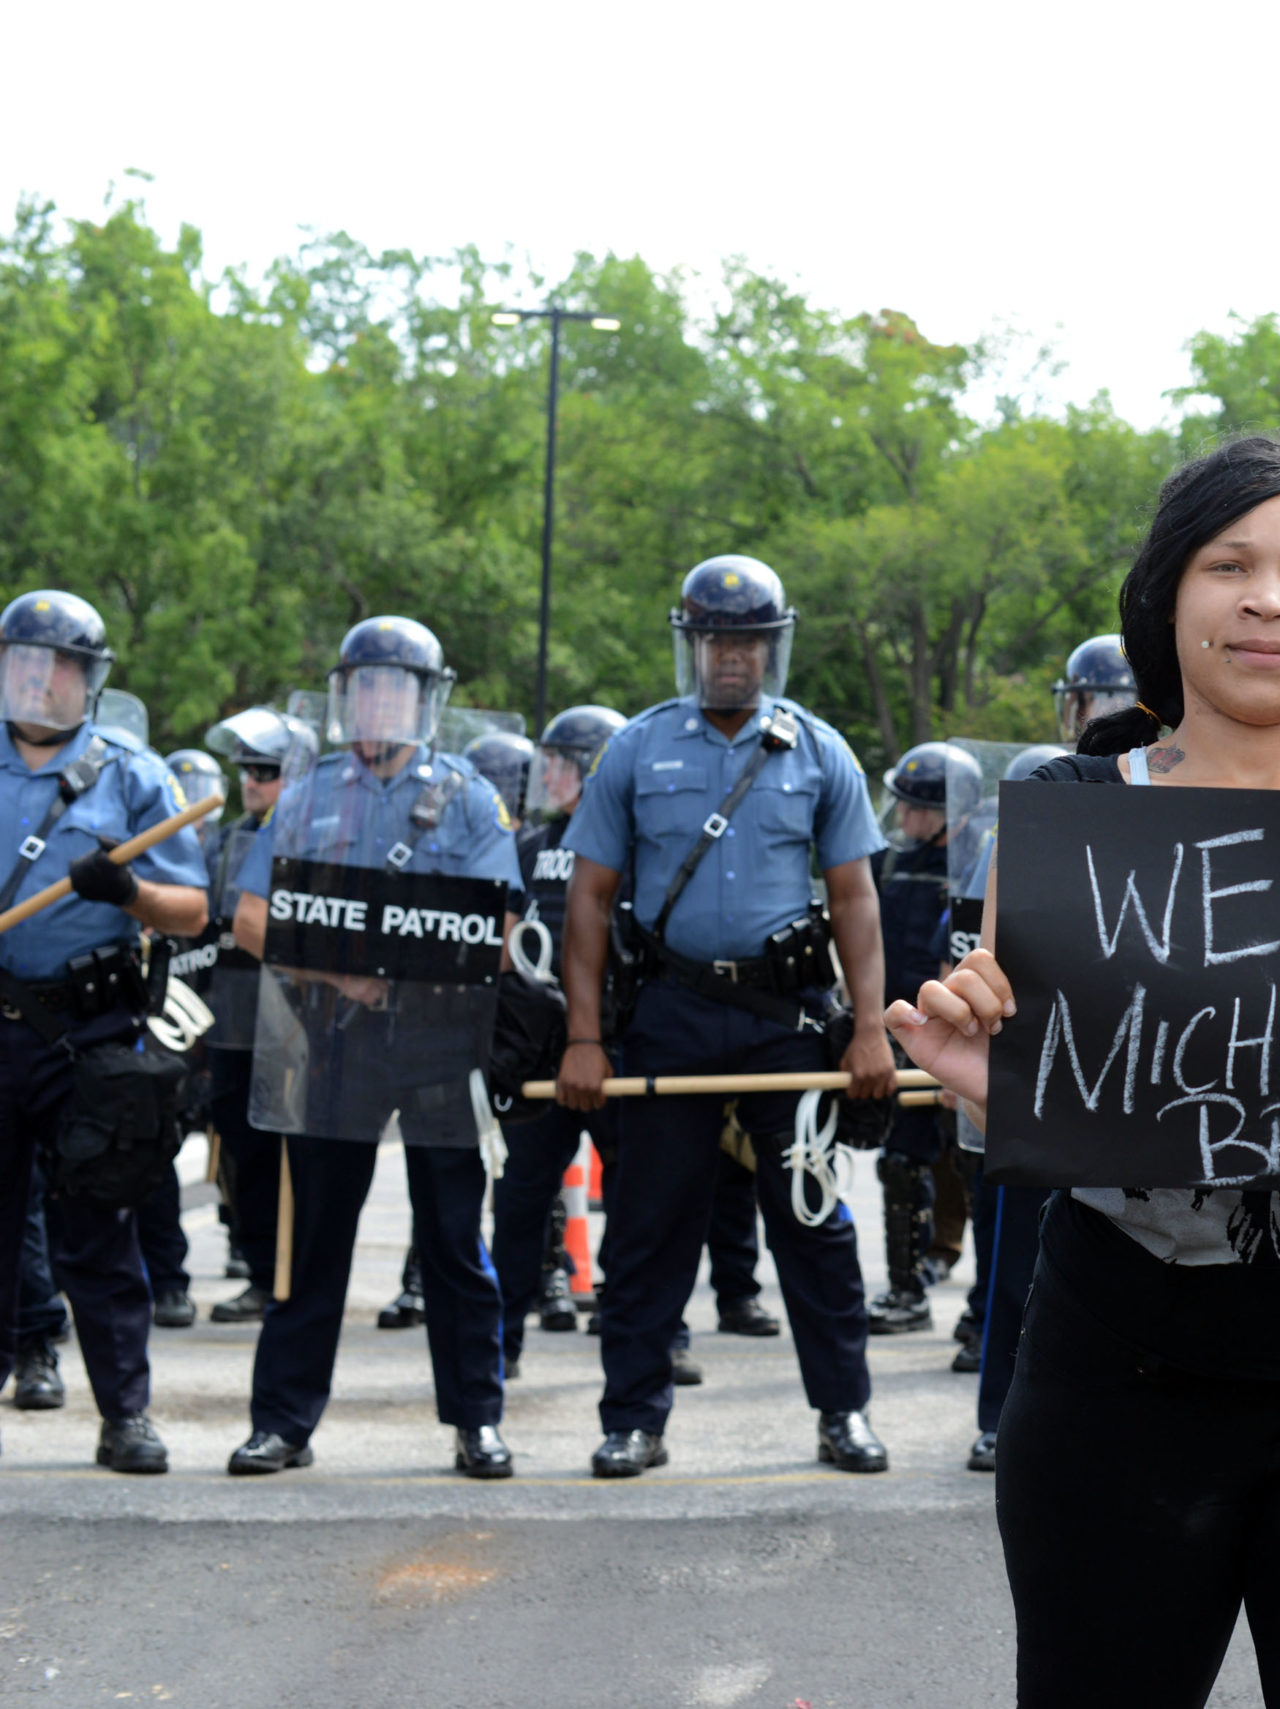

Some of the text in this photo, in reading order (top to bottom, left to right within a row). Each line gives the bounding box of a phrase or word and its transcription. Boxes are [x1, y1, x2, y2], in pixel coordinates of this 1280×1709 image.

[532, 848, 576, 880] TROO
[270, 889, 504, 946] STATE PATROL
